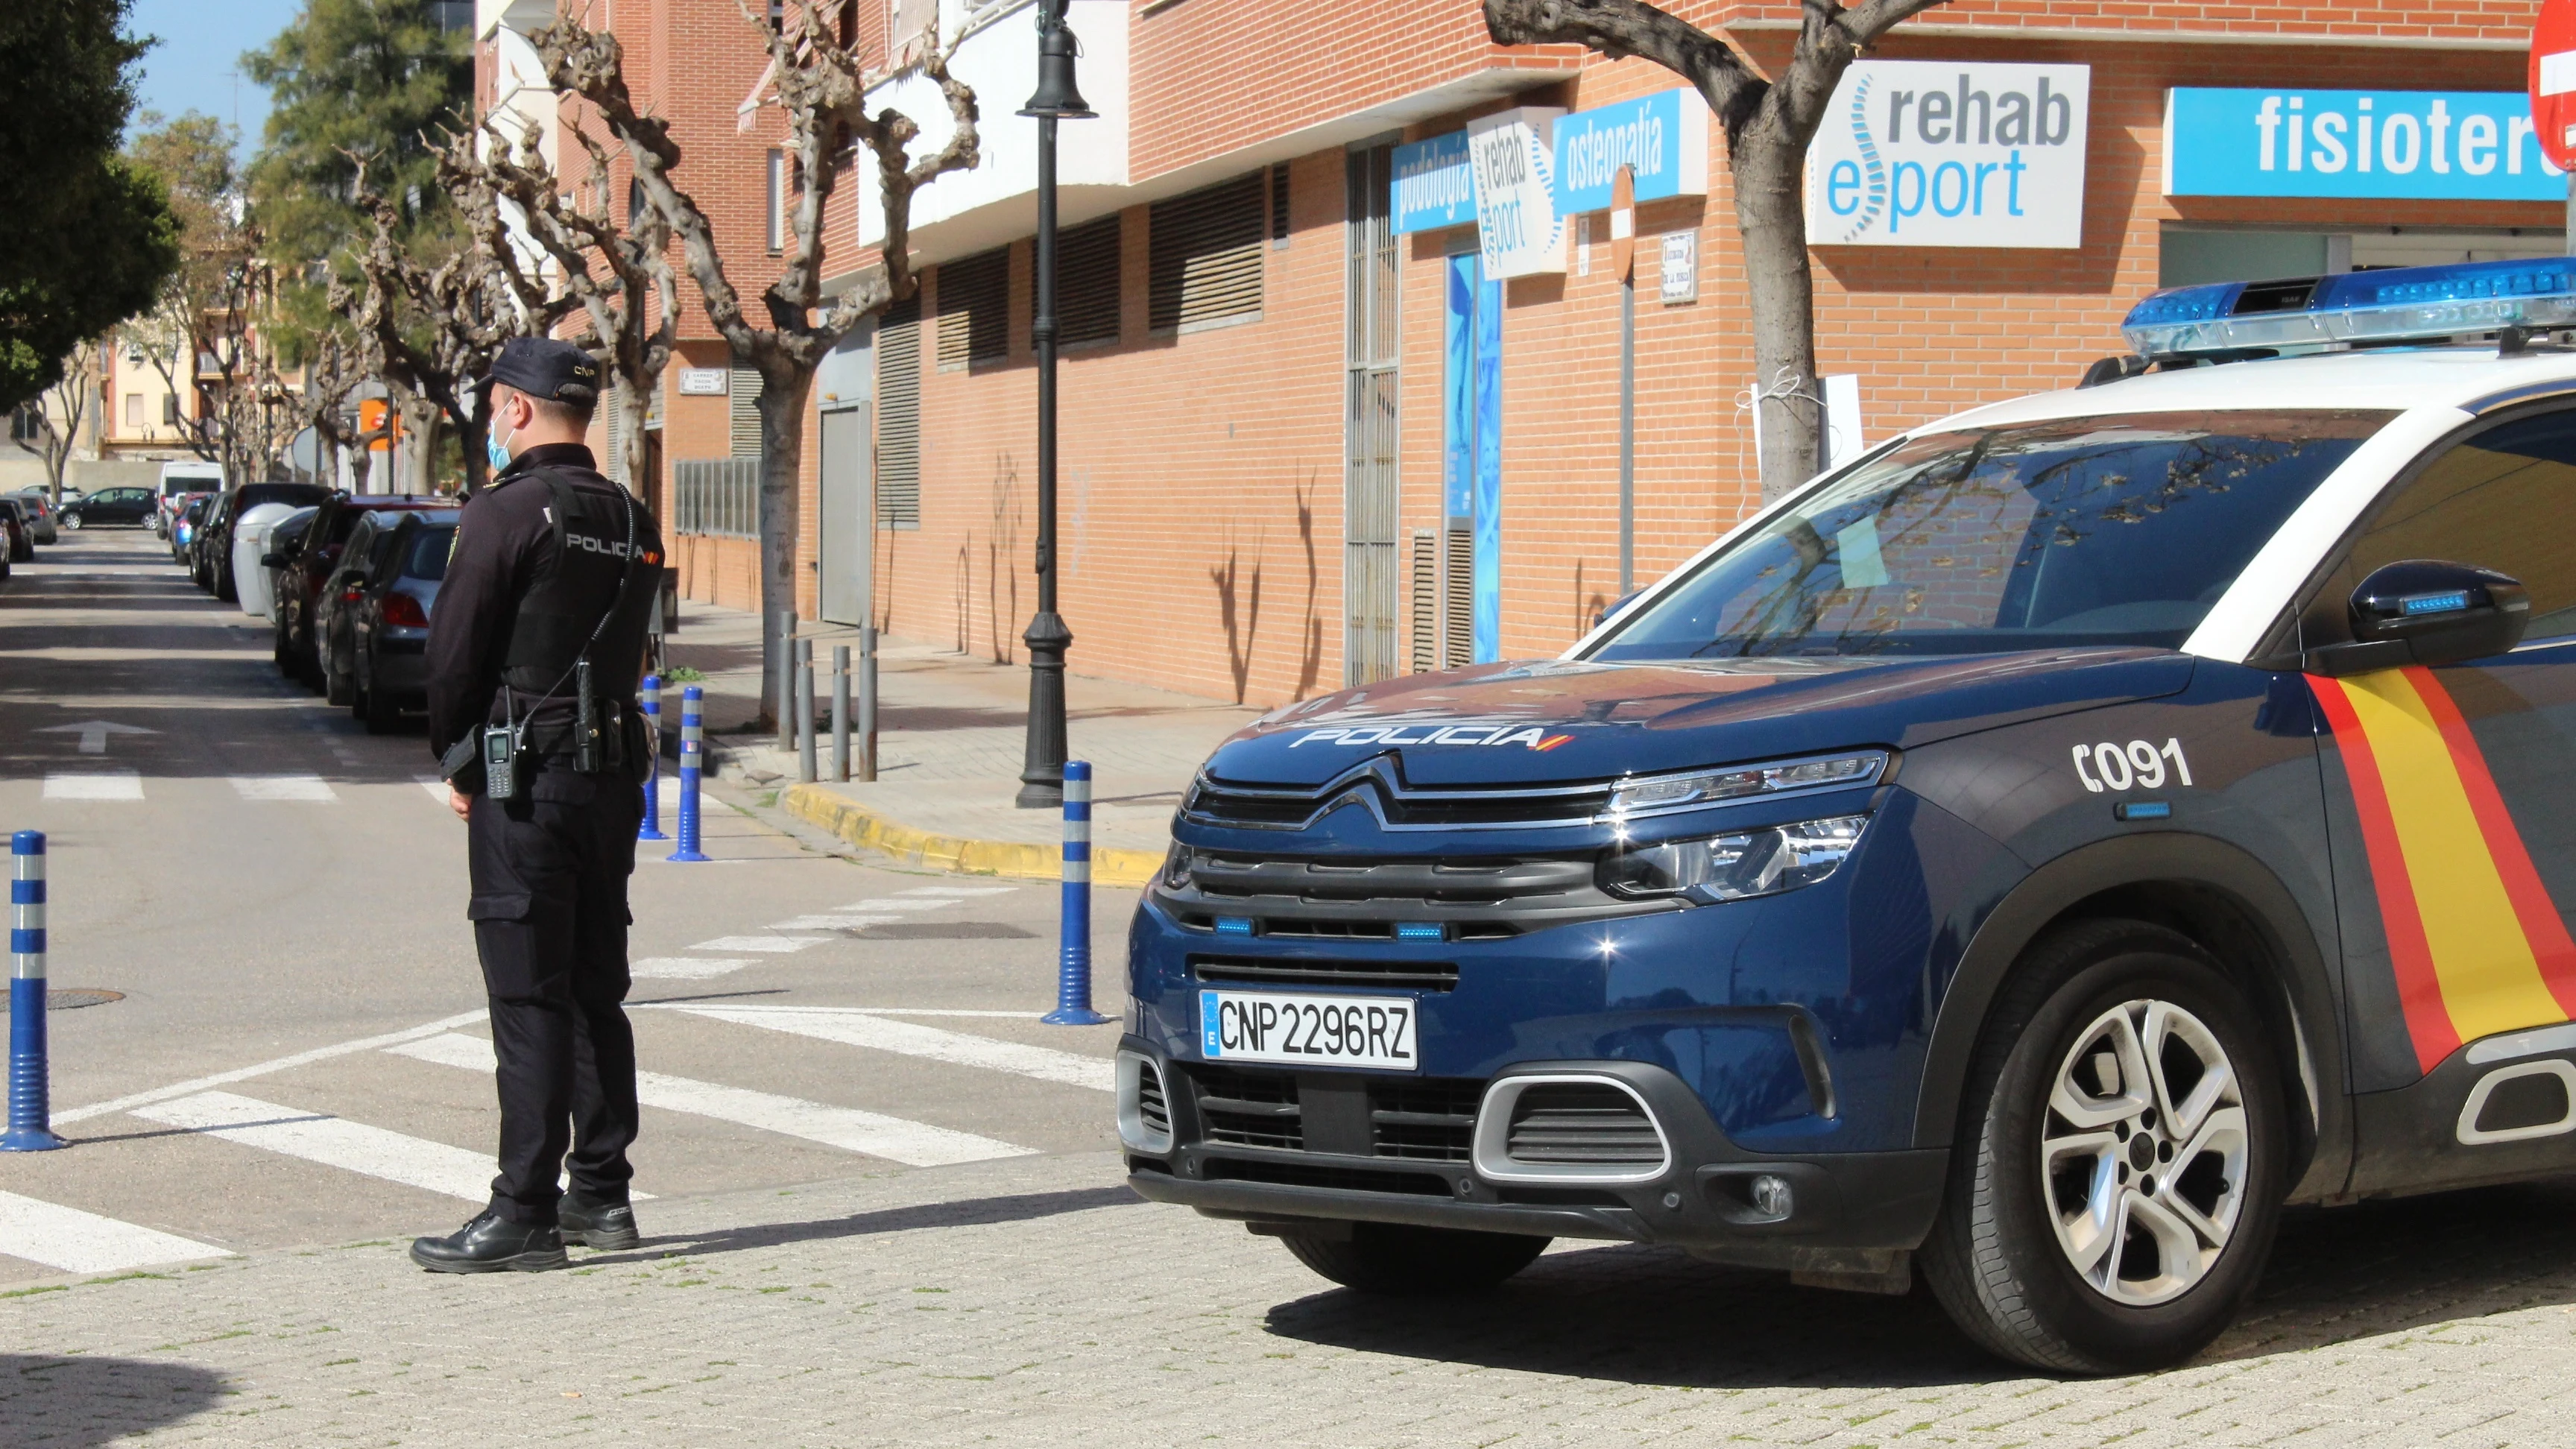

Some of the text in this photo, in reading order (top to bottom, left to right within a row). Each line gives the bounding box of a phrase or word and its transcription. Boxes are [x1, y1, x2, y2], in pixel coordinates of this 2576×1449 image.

[1888, 73, 2071, 146] rehab
[1399, 134, 1470, 230] podología
[1483, 120, 1526, 191] rehab
[574, 365, 596, 378] CNP
[566, 533, 646, 560] POLICA
[2094, 737, 2193, 791] 091
[1208, 1031, 1216, 1046] E
